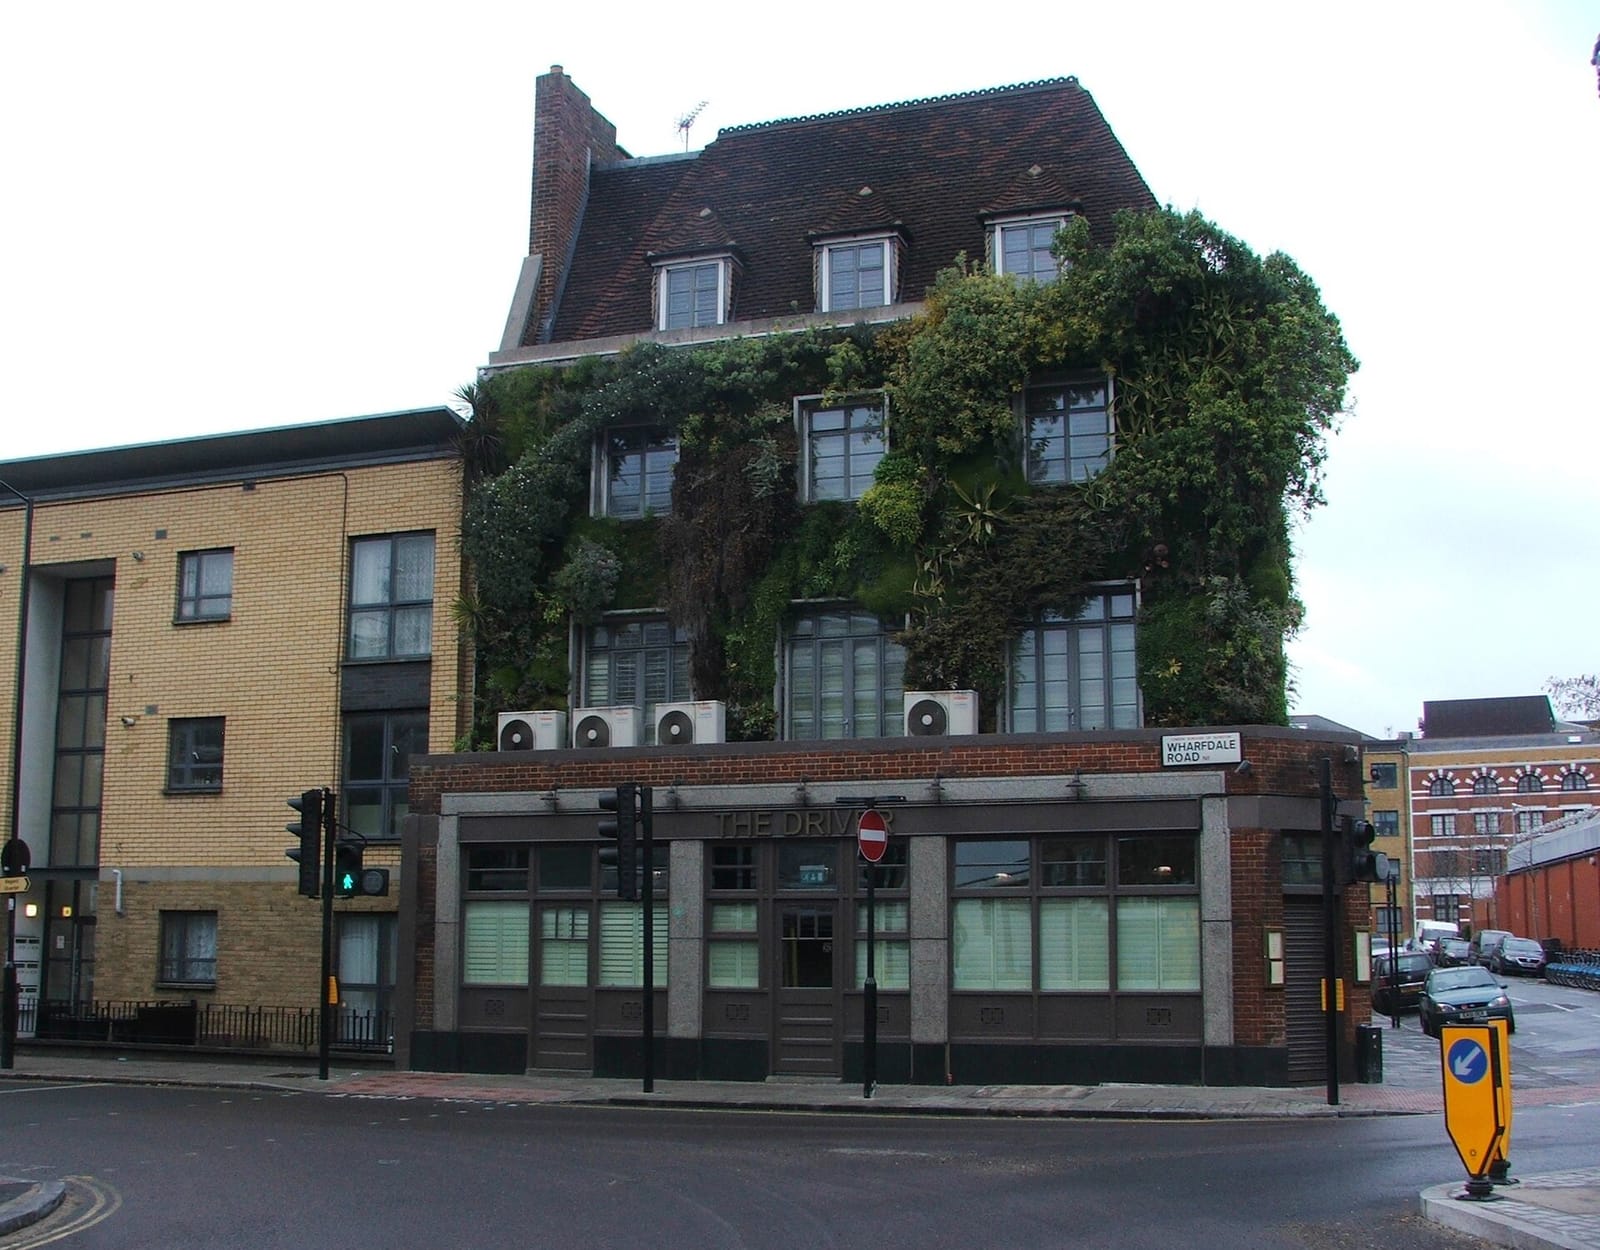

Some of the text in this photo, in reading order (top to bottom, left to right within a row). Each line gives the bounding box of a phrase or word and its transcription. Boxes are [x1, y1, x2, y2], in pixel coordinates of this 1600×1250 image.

[1167, 740, 1236, 752] WHARFDALE
[1167, 752, 1200, 763] ROAD
[715, 811, 773, 838] THE
